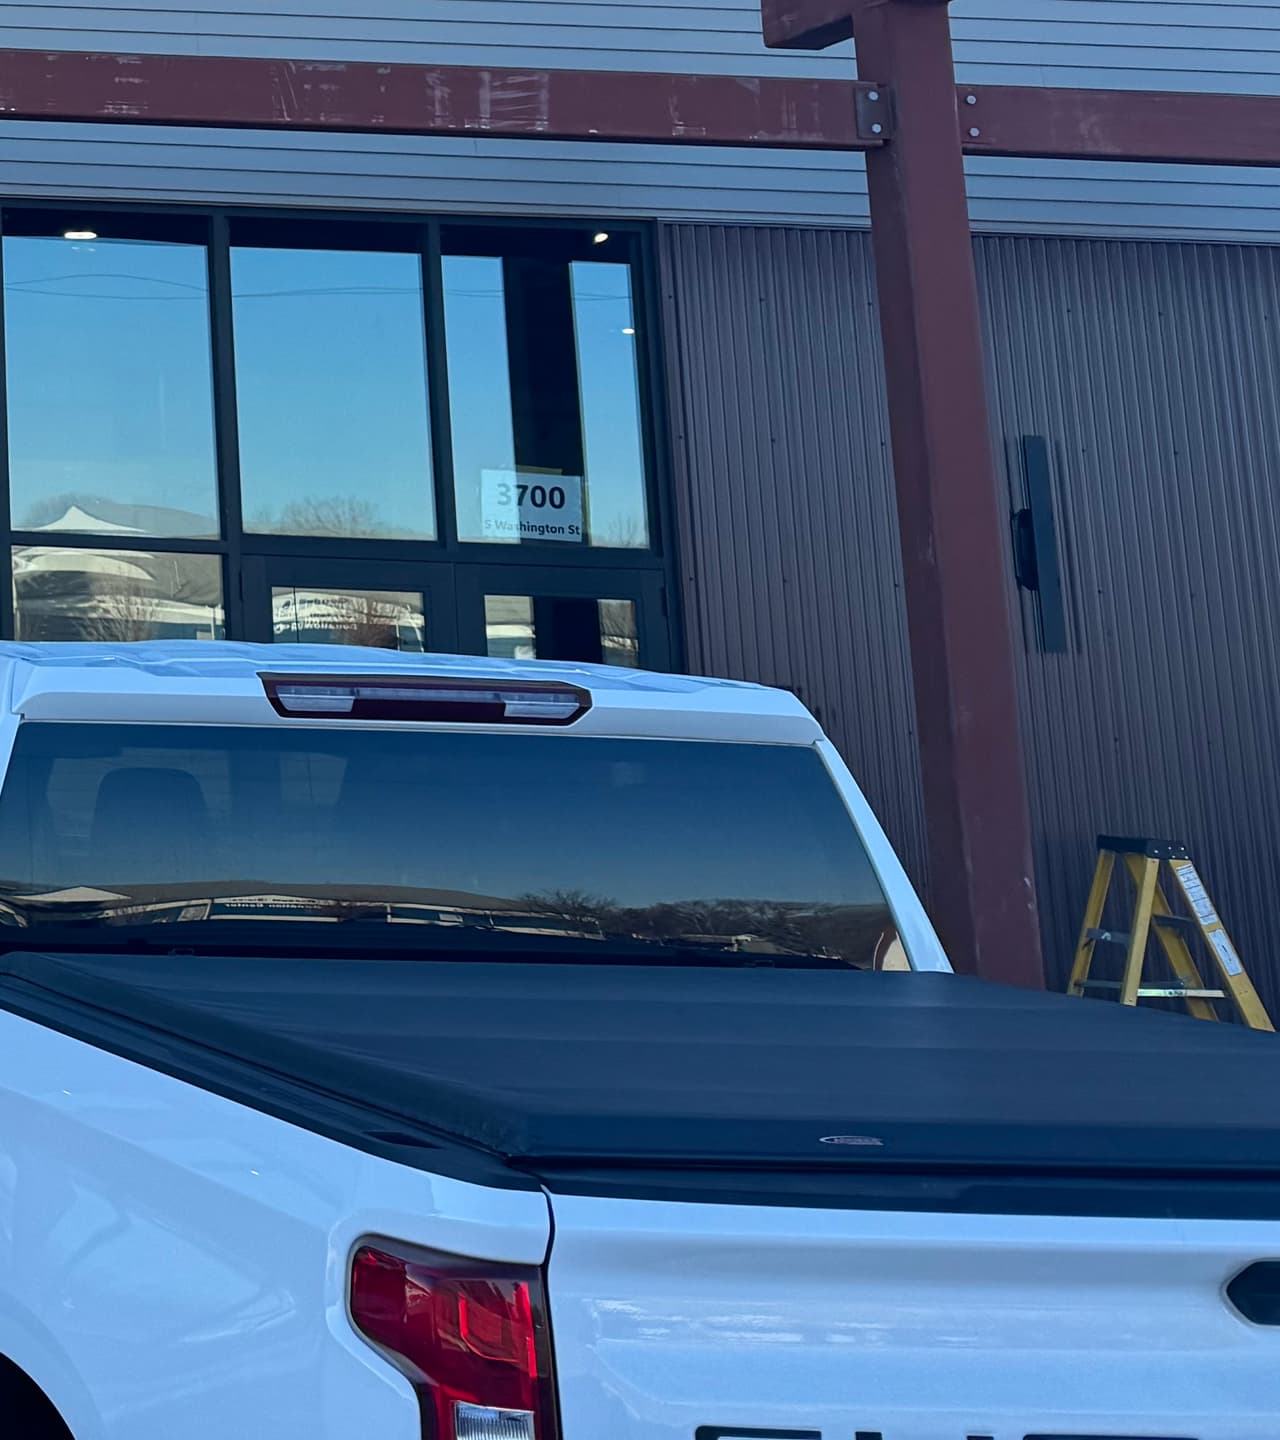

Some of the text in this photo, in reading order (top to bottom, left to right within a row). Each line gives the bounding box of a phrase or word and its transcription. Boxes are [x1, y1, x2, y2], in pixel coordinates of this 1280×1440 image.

[497, 483, 565, 509] 3700
[495, 519, 565, 536] Wahington
[568, 524, 580, 536] St
